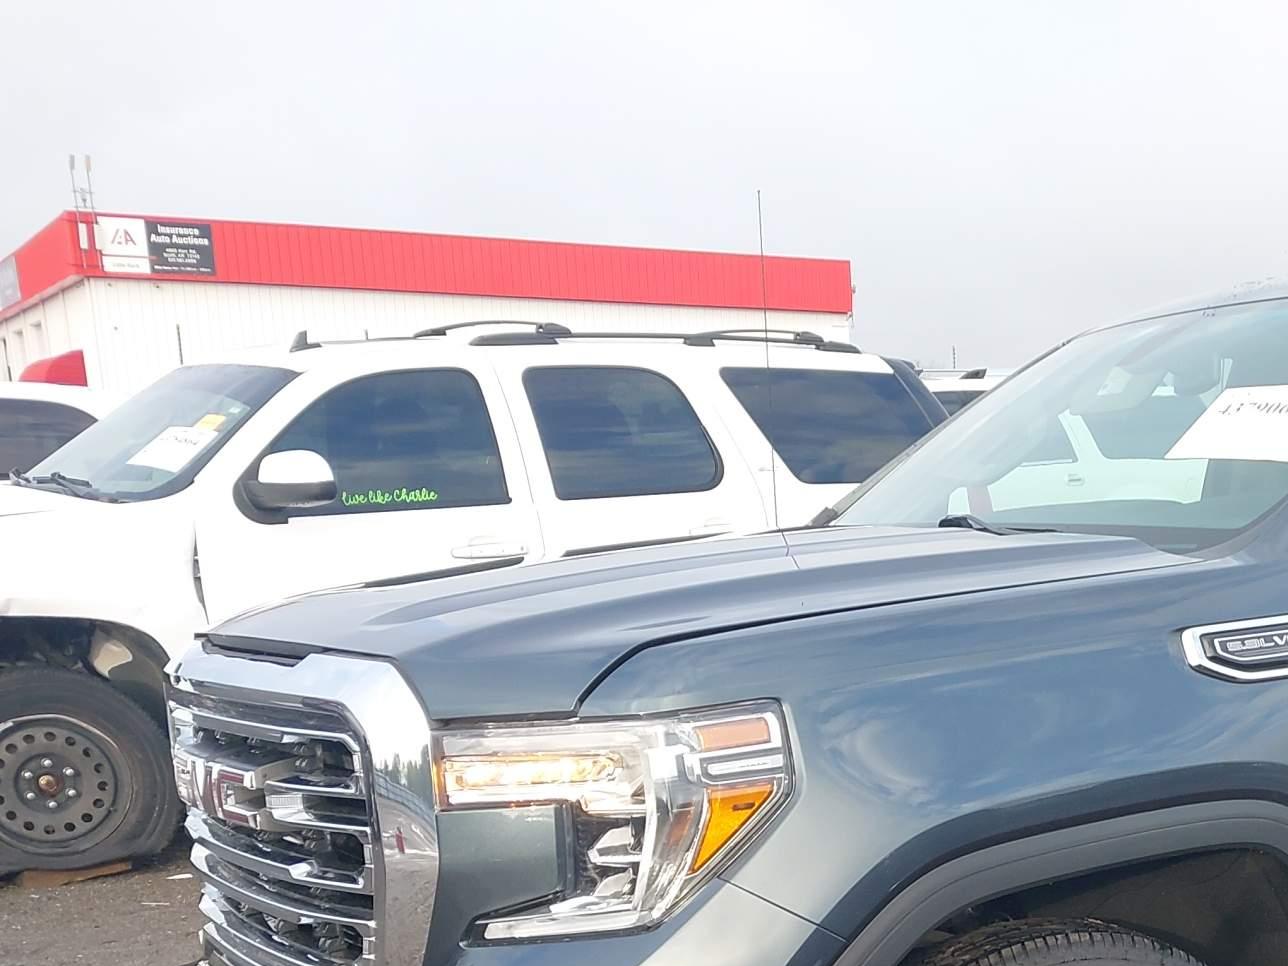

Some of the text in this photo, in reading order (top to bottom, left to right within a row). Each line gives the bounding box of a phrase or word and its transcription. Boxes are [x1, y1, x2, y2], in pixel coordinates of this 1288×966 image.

[158, 224, 200, 235] Insurance
[150, 233, 209, 246] Auto Auctions
[368, 490, 392, 504] like
[393, 487, 438, 503] Charlie
